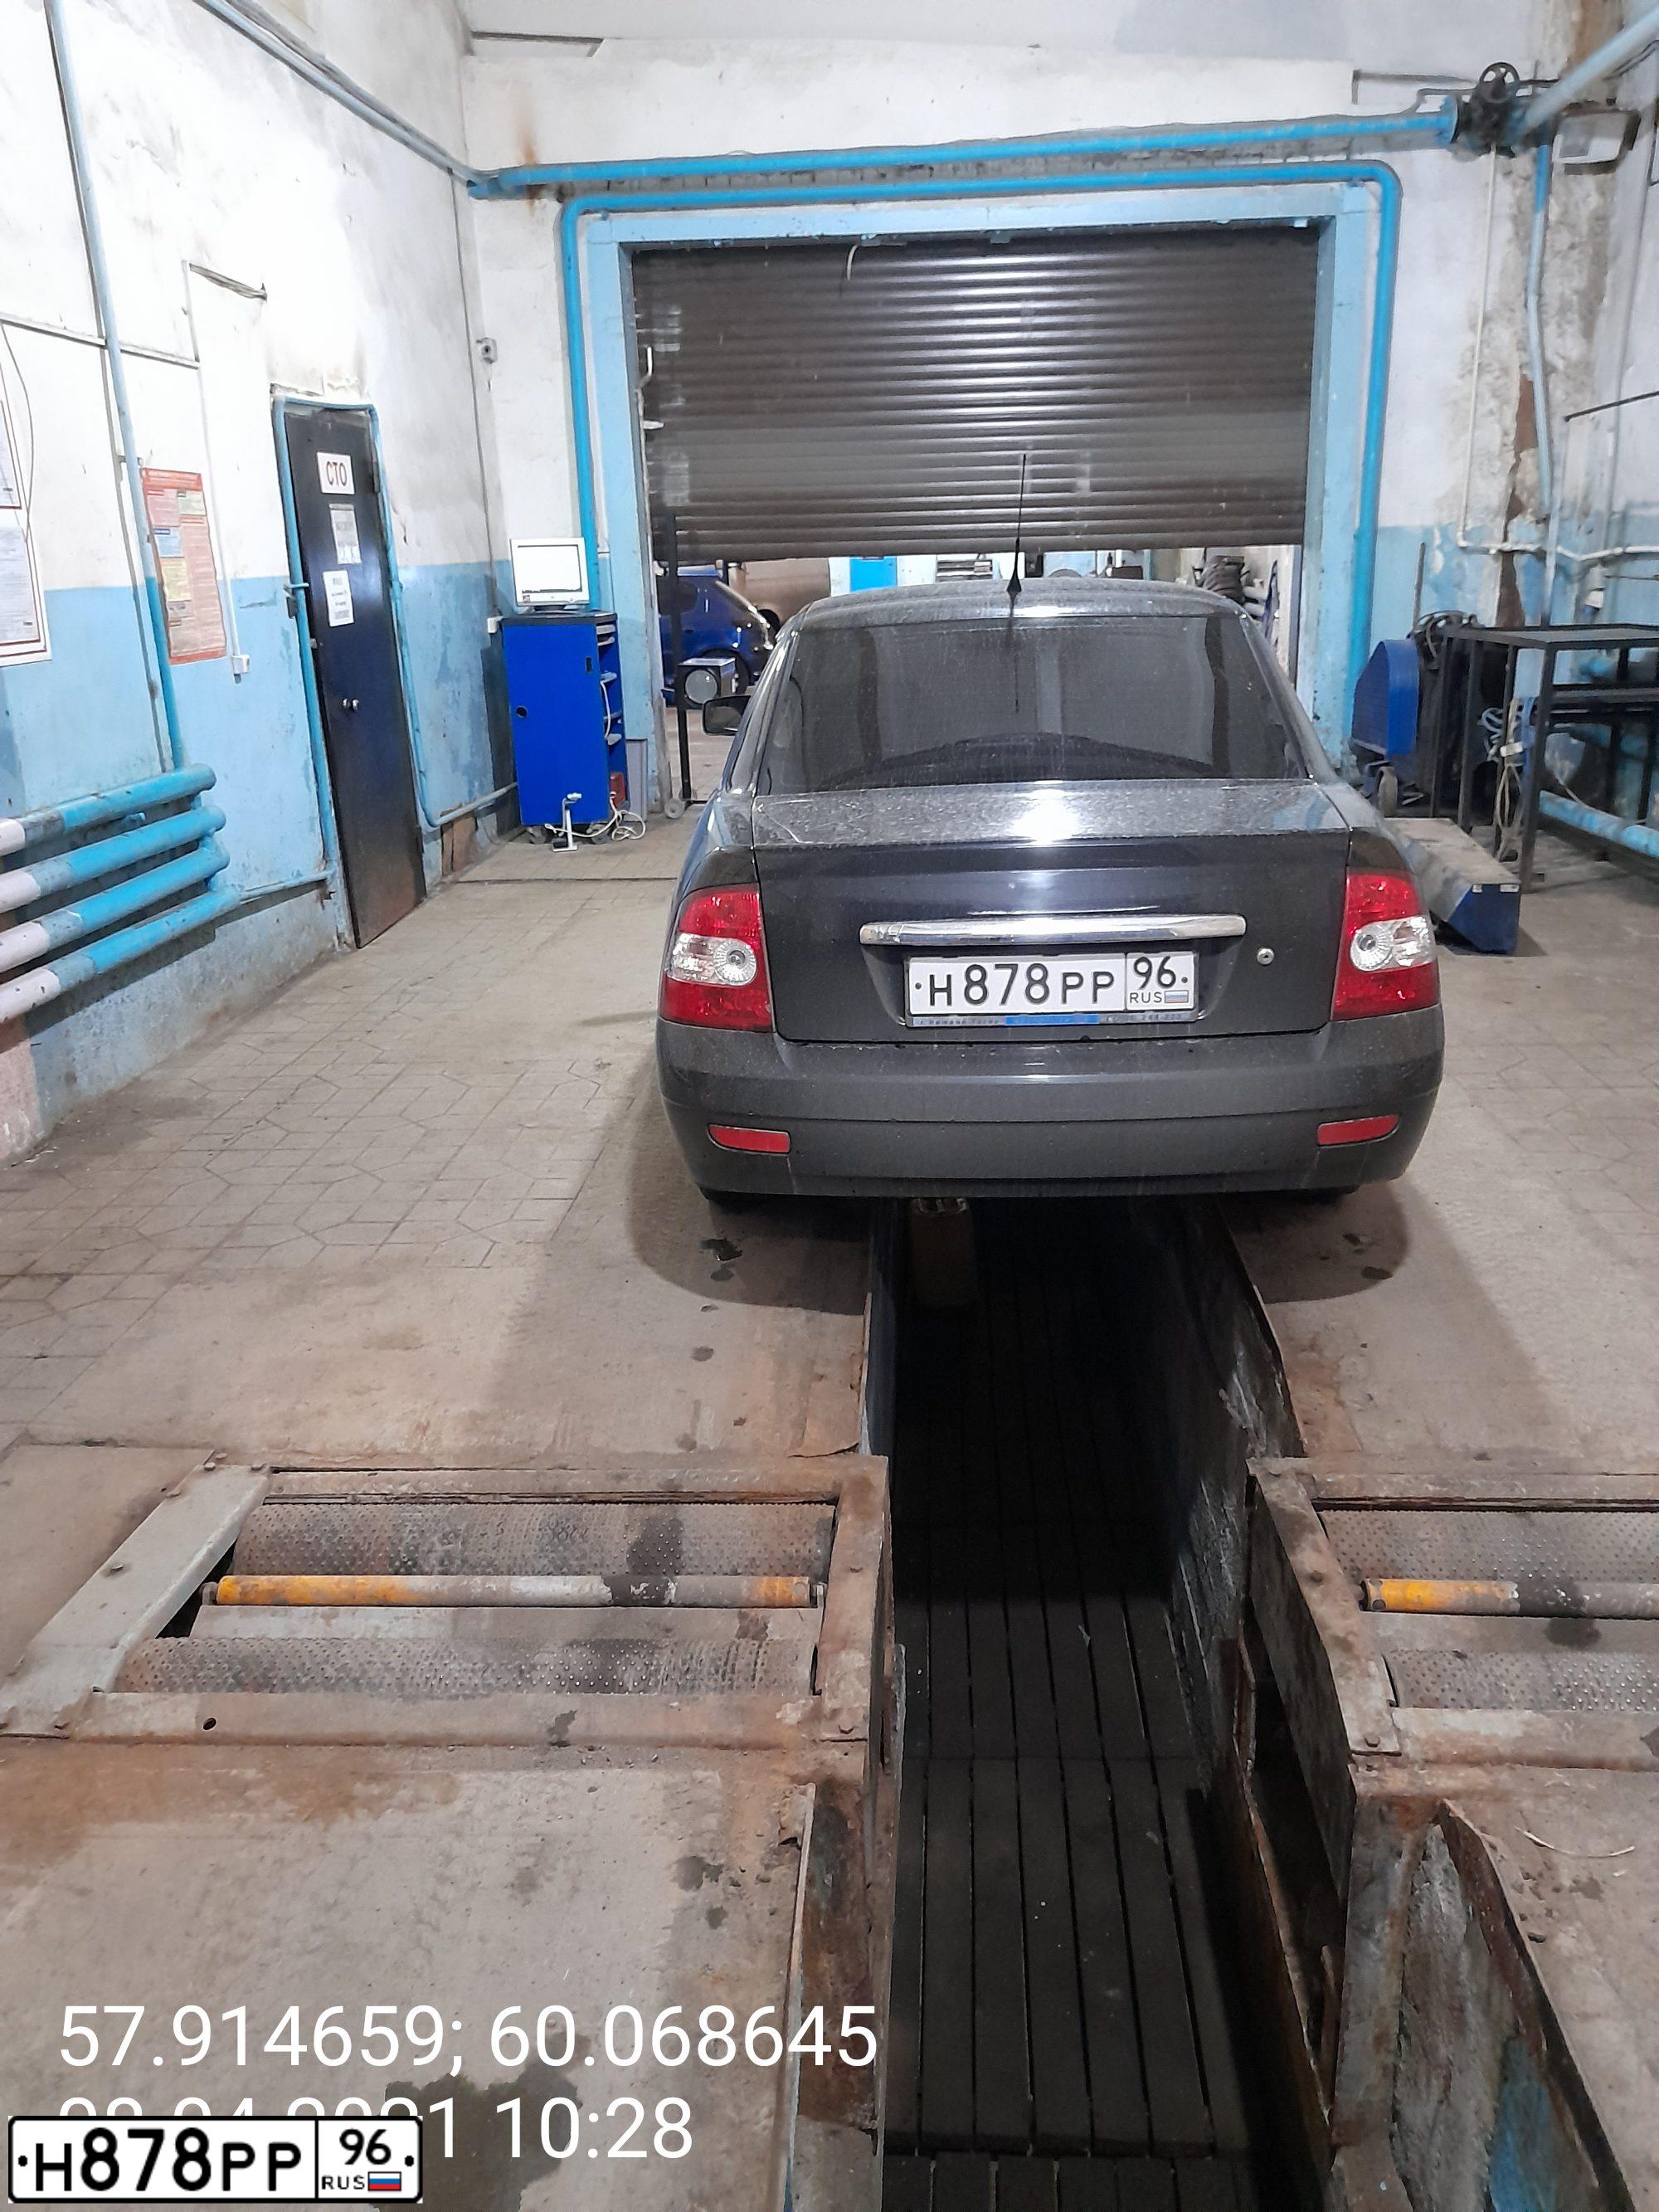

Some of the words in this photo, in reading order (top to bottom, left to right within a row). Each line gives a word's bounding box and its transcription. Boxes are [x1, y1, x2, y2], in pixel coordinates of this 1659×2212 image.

[326, 460, 348, 487] СТО
[1133, 956, 1176, 990] 96
[1129, 992, 1162, 1004] RUS
